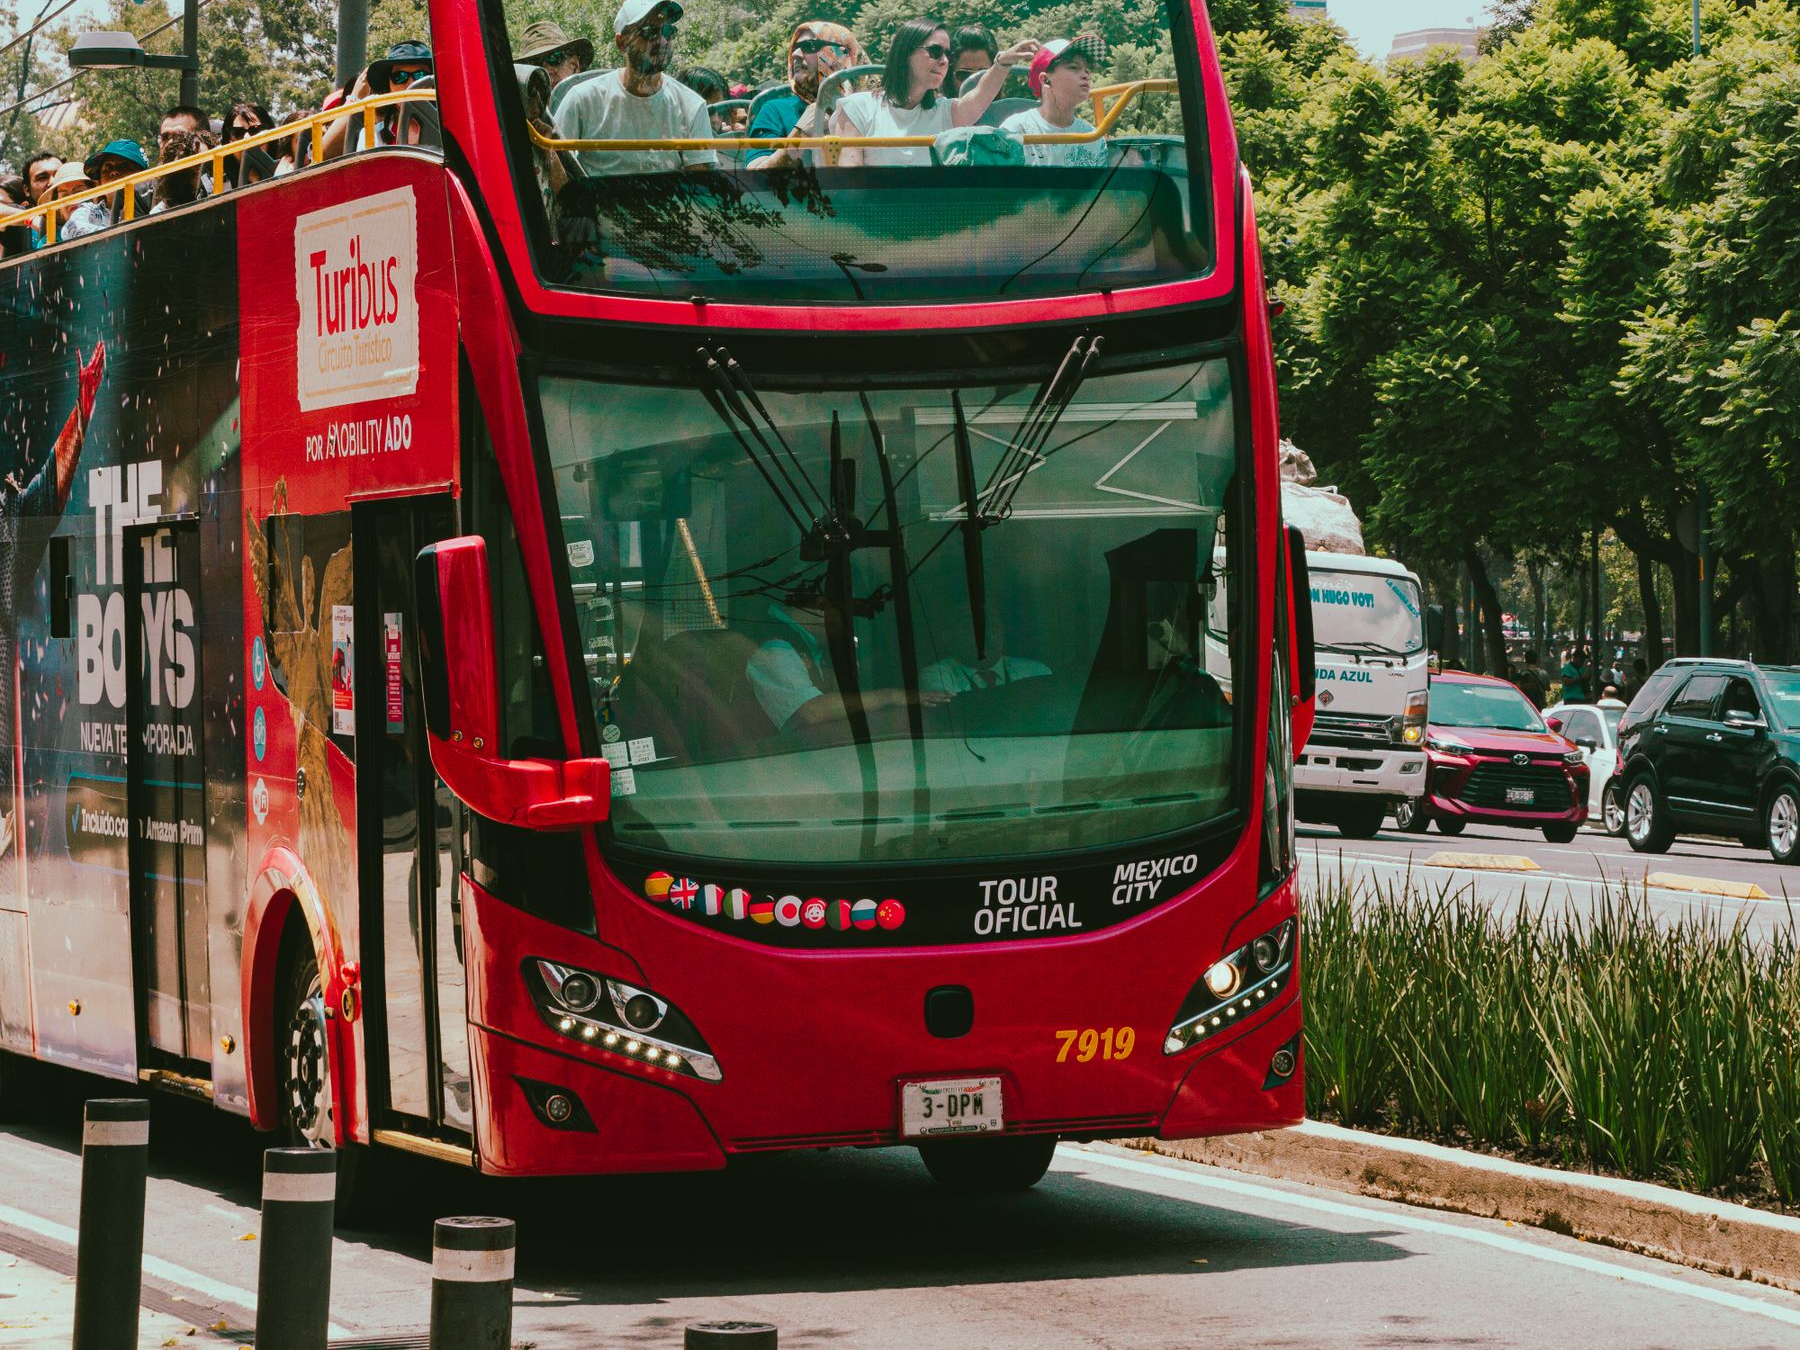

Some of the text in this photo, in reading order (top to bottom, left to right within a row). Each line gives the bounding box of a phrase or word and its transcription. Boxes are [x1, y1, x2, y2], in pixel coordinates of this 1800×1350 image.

[310, 234, 399, 337] Turibus
[319, 330, 392, 374] Circuito Turístico
[306, 413, 412, 462] POR MOBILITY ADO
[88, 460, 178, 585] THE
[1321, 589, 1350, 605] HUGO
[1351, 591, 1375, 608] VOY!
[78, 588, 195, 709] BOYS
[1339, 671, 1374, 683] AZUL
[81, 722, 114, 753] NUEVA
[81, 808, 114, 836] Incluido
[146, 816, 178, 843] Amazon
[1113, 854, 1198, 884] MEXICO
[979, 876, 1058, 906] TOUR
[1112, 880, 1163, 905] CITY
[974, 902, 1083, 935] OFICIAL
[1055, 1027, 1136, 1063] 7919
